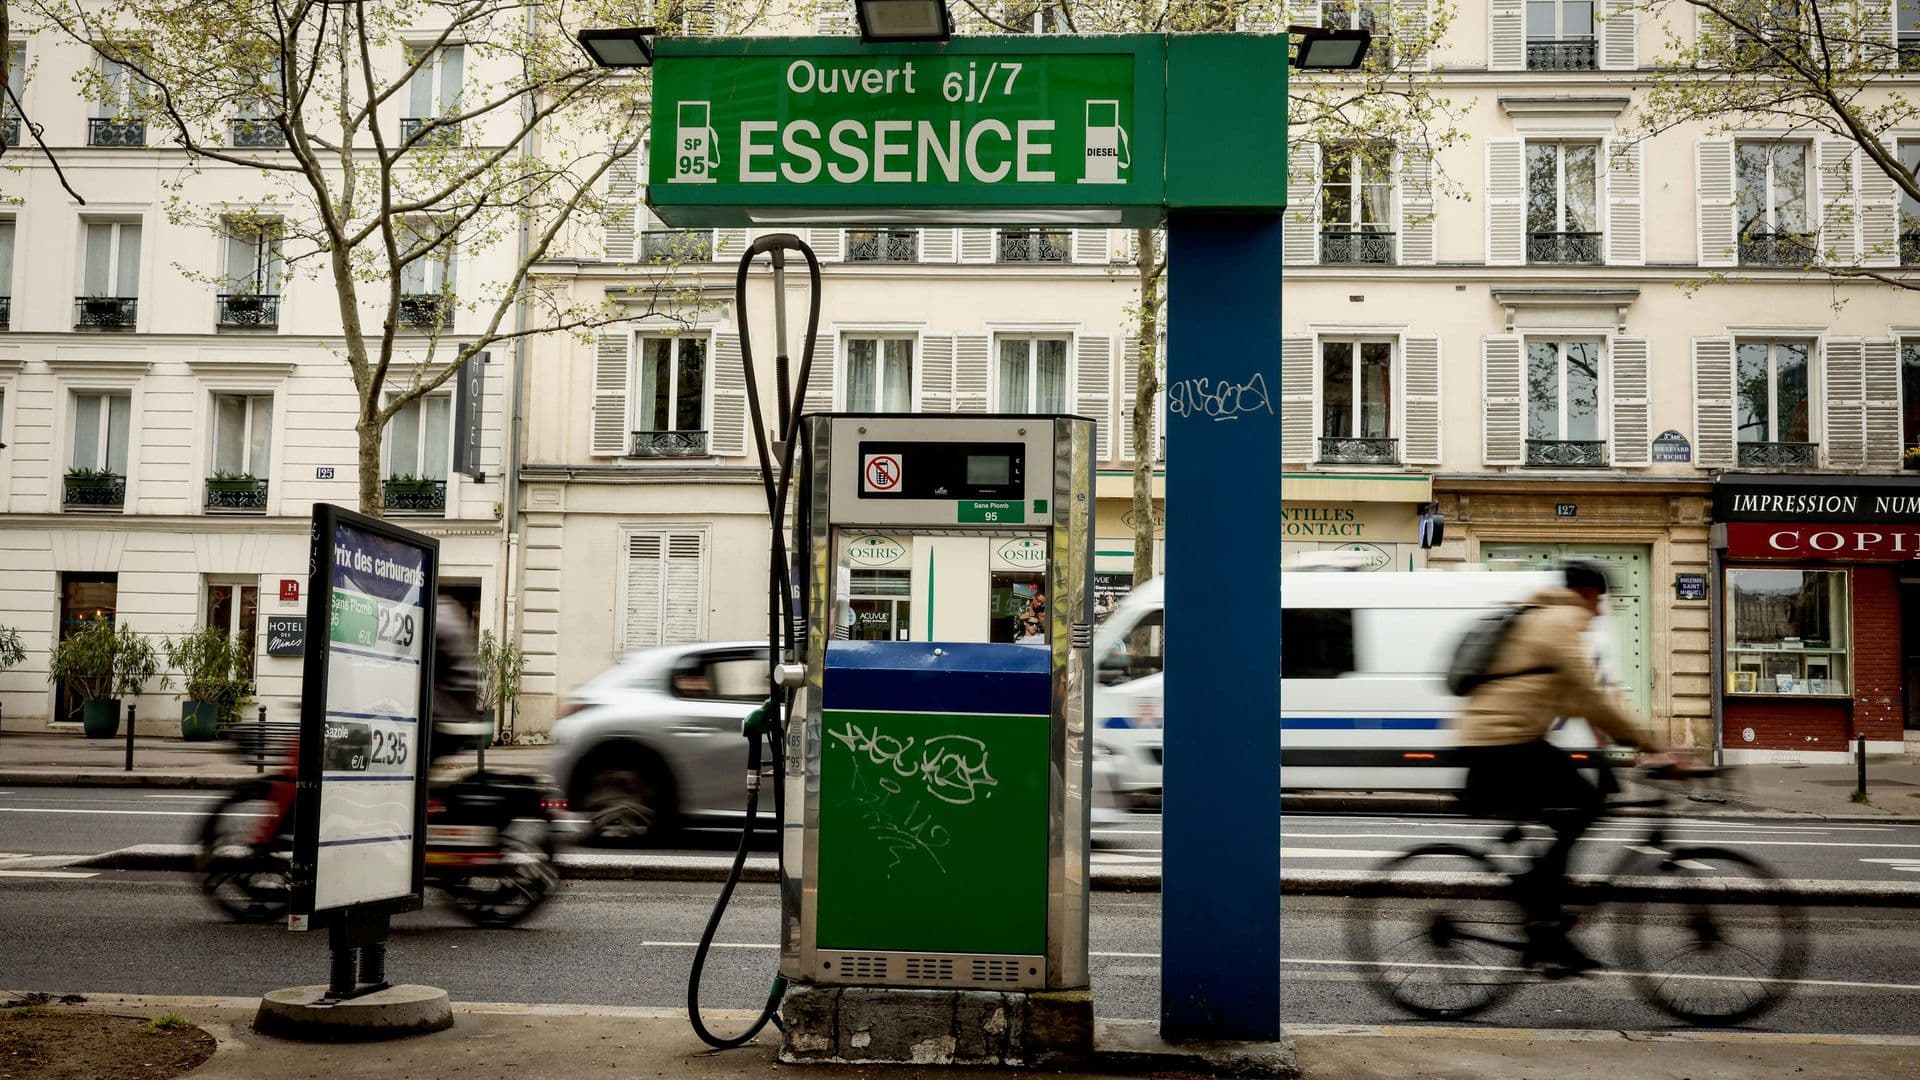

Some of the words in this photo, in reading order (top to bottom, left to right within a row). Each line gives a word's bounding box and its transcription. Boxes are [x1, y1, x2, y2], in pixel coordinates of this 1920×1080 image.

[786, 60, 916, 94] Ouvert
[942, 61, 1023, 103] 6j/7
[684, 138, 702, 151] SP
[739, 119, 1056, 184] ESSENCE
[1086, 147, 1118, 157] DIESEL
[679, 156, 705, 175] 95
[469, 354, 479, 469] HOTEL
[318, 468, 333, 478] 125
[1558, 505, 1575, 516] 127
[1732, 494, 1858, 514] IMPRESSION
[1875, 496, 1920, 514] NUM
[985, 512, 998, 521] 95
[1281, 508, 1354, 521] NTILLES
[1281, 523, 1364, 536] ONTACT
[850, 547, 898, 559] OSIRIS
[1004, 549, 1045, 561] OSIRI
[354, 548, 373, 574] des
[374, 556, 425, 588] carburants
[288, 583, 297, 592] H
[331, 594, 350, 611] Sans
[350, 598, 373, 616] Plomb
[269, 622, 303, 632] HOTEL
[378, 607, 414, 647] 2.29
[269, 636, 302, 651] Mines
[371, 729, 408, 765] 2.35
[351, 754, 365, 769] €/L
